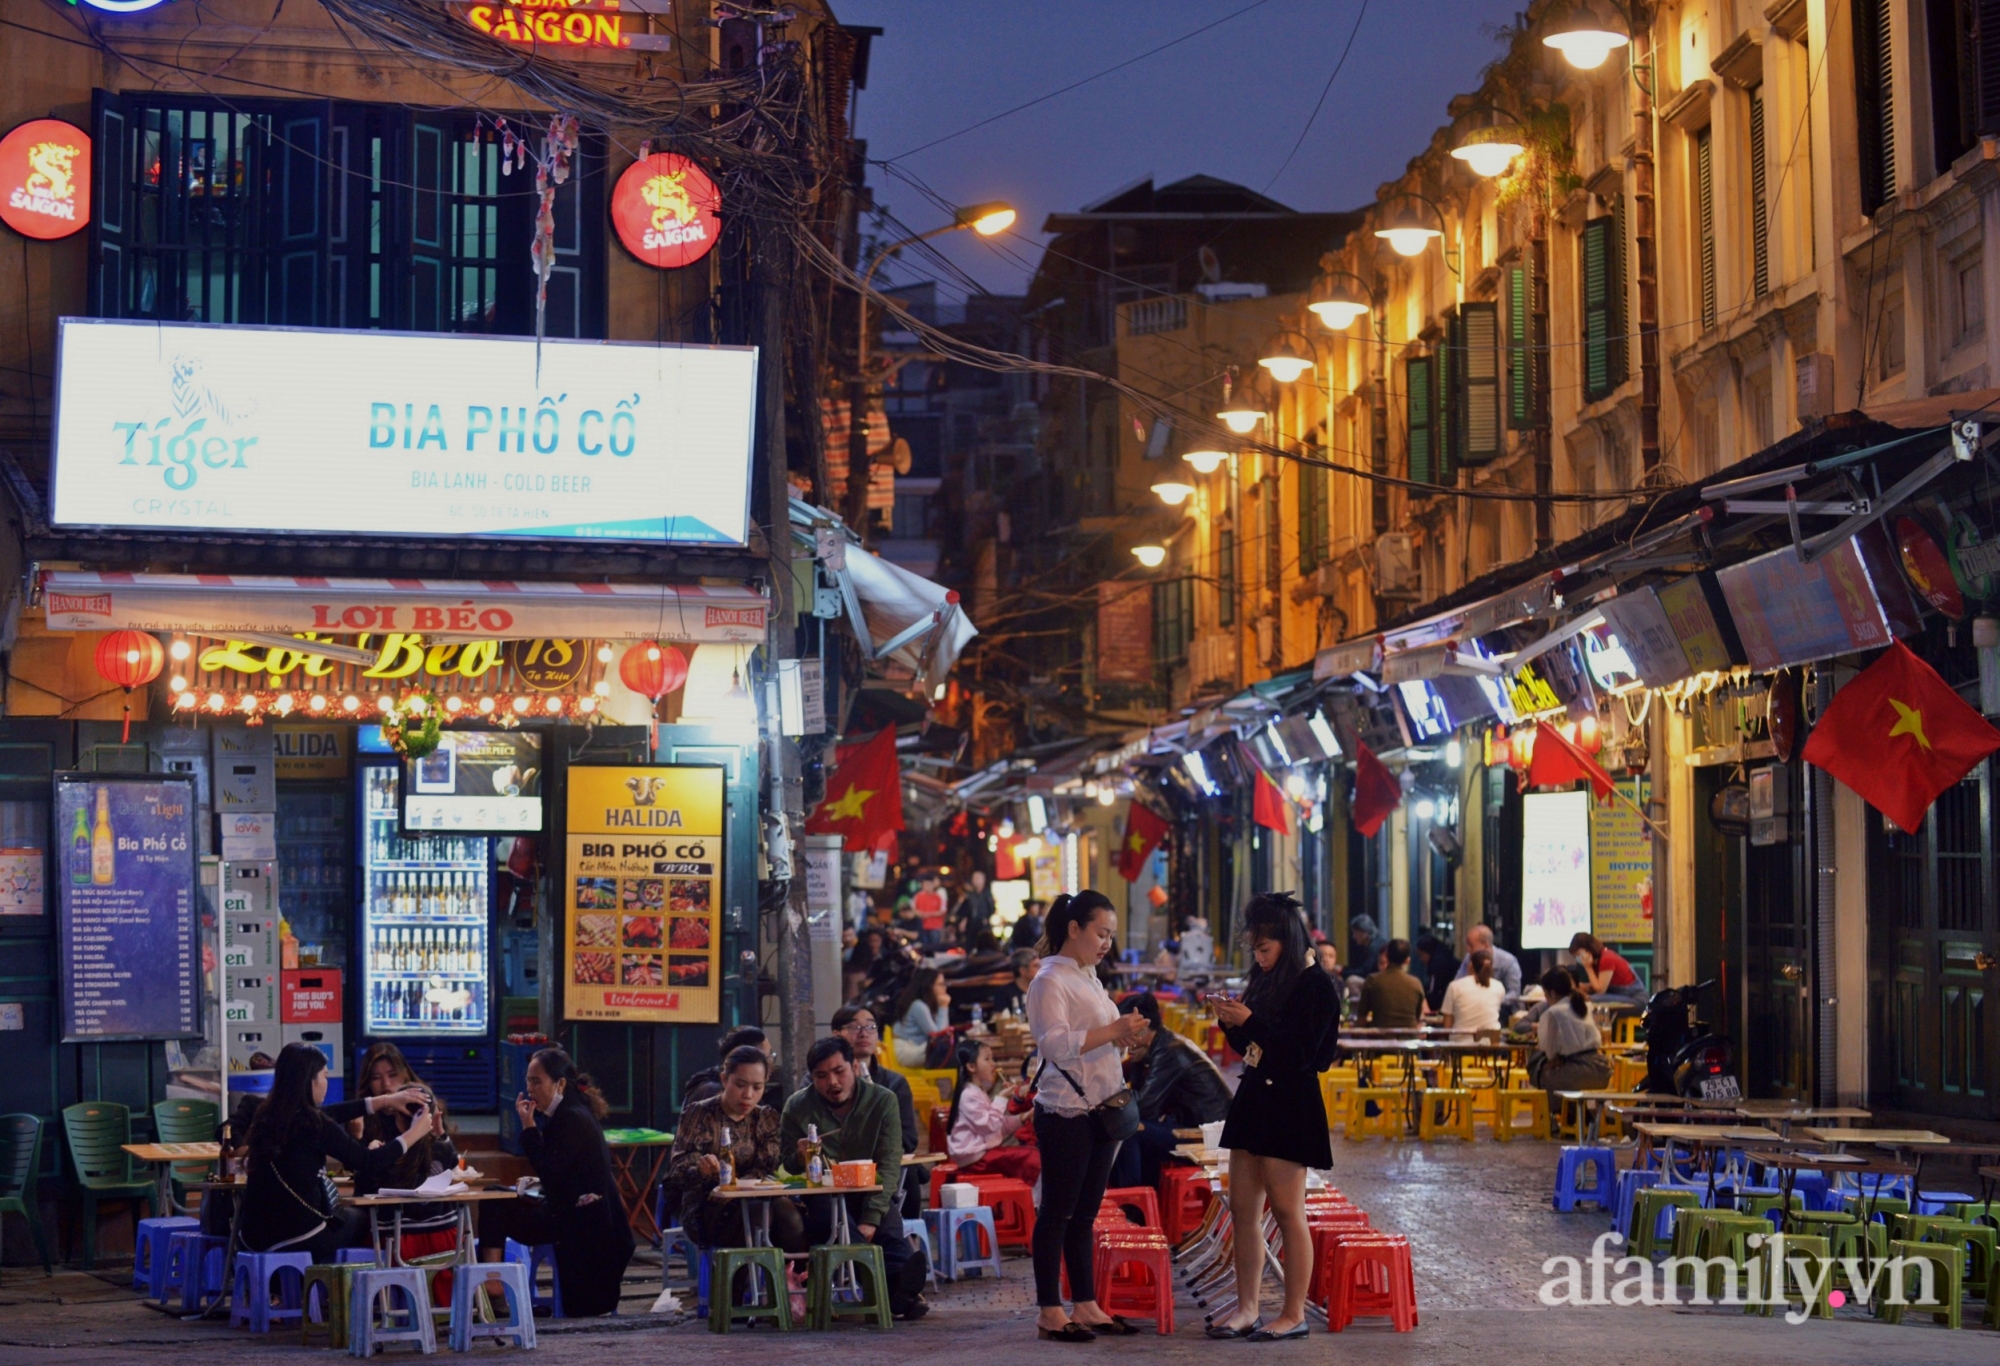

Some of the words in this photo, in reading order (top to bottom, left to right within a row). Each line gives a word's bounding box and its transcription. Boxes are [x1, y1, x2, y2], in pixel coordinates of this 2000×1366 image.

[468, 5, 622, 47] SAIGON
[9, 191, 75, 220] SAIGON
[663, 218, 684, 231] BIA
[643, 225, 706, 250] SAIGON
[369, 402, 447, 450] BIA
[466, 393, 567, 454] PHỐ
[578, 393, 641, 457] CỔ
[112, 417, 259, 491] Tiger
[411, 470, 438, 488] BIA
[504, 473, 545, 492] COLD
[551, 475, 591, 493] BEER
[133, 498, 233, 516] CRYSTAL
[51, 594, 83, 611] HANOI
[85, 596, 110, 613] BEER
[411, 600, 514, 632] BÉO
[707, 608, 737, 625] HANOI
[740, 609, 762, 626] BEER
[1853, 619, 1879, 641] SAIGON
[156, 803, 183, 820] Light
[605, 808, 683, 827] HALIDA
[118, 837, 139, 850] Bia
[143, 833, 167, 850] Phố
[171, 832, 187, 850] Cổ
[582, 843, 615, 857] BIA
[622, 840, 668, 858] PHỐ
[675, 839, 705, 859] CỔ
[661, 863, 701, 875] BBQ
[293, 991, 310, 1000] THIS
[311, 991, 334, 1001] BUD'S
[293, 1001, 308, 1010] FOR
[309, 1001, 326, 1010] YOU.
[611, 990, 671, 1007] Welcome!
